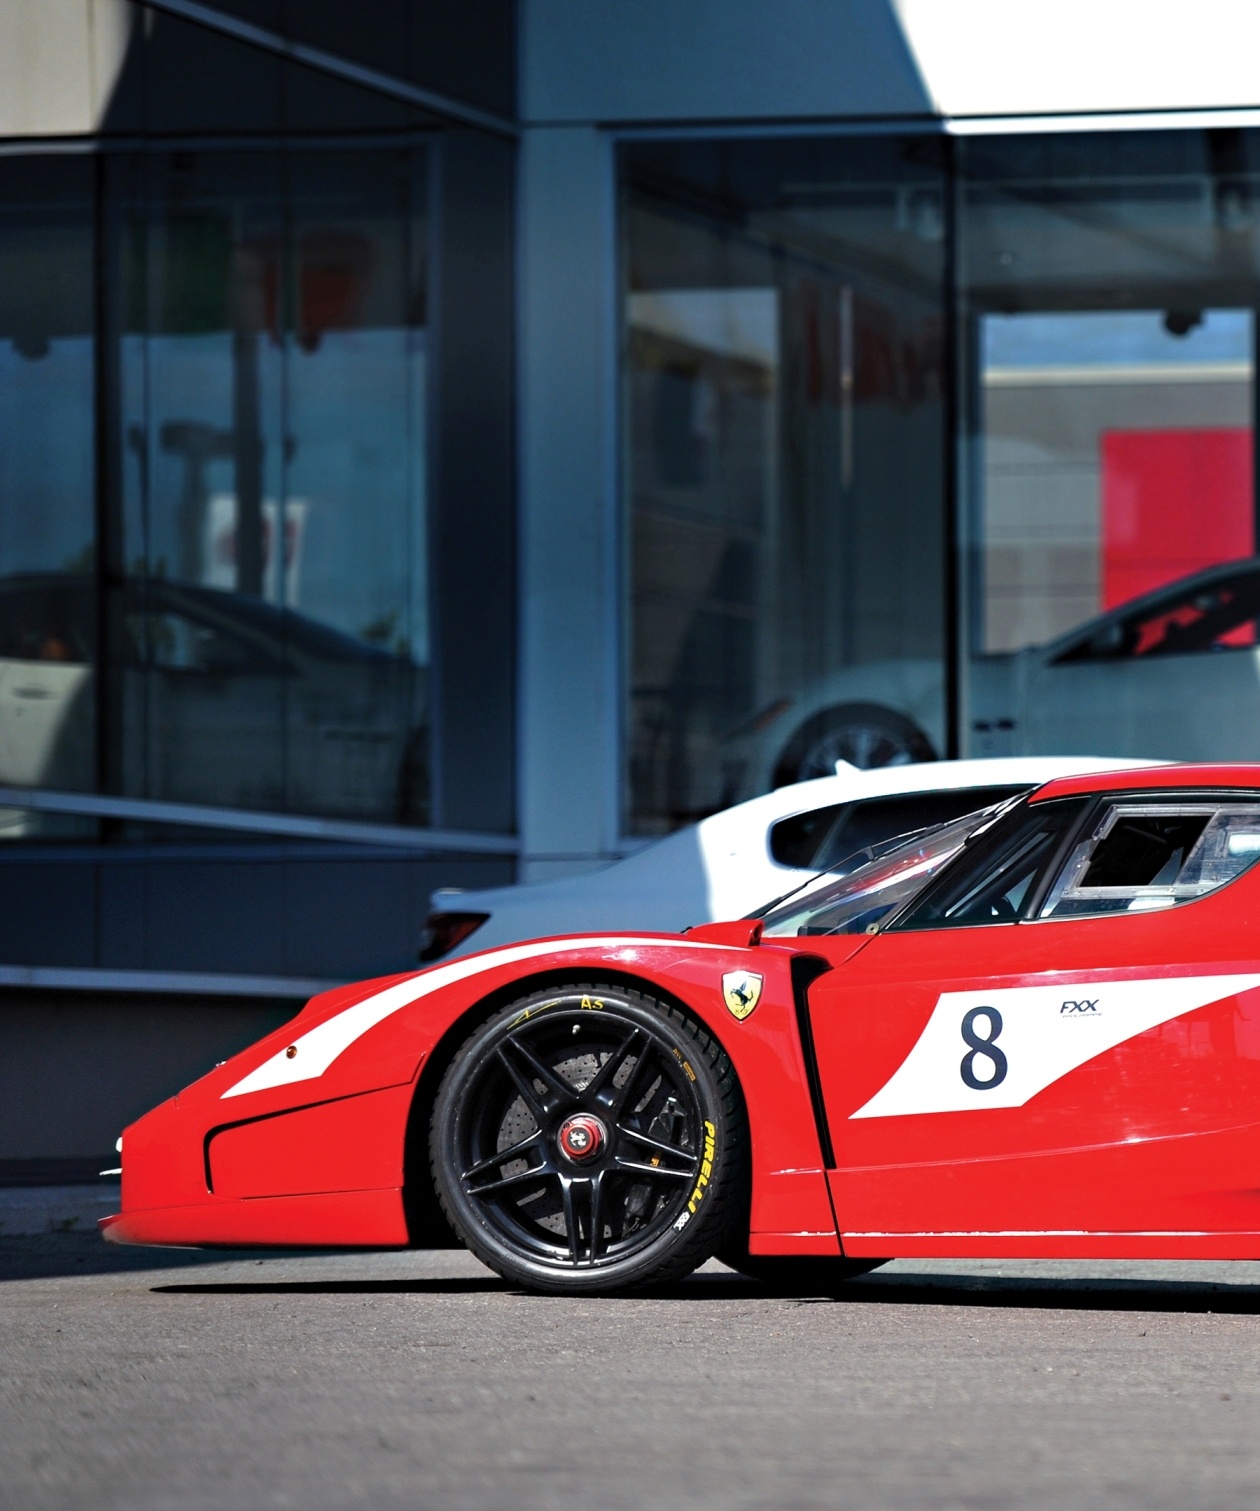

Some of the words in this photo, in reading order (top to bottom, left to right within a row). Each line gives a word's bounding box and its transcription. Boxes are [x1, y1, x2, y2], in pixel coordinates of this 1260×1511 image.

[960, 1006, 1008, 1090] 8
[1060, 999, 1100, 1014] FXX
[688, 1121, 715, 1213] PIRELLI
